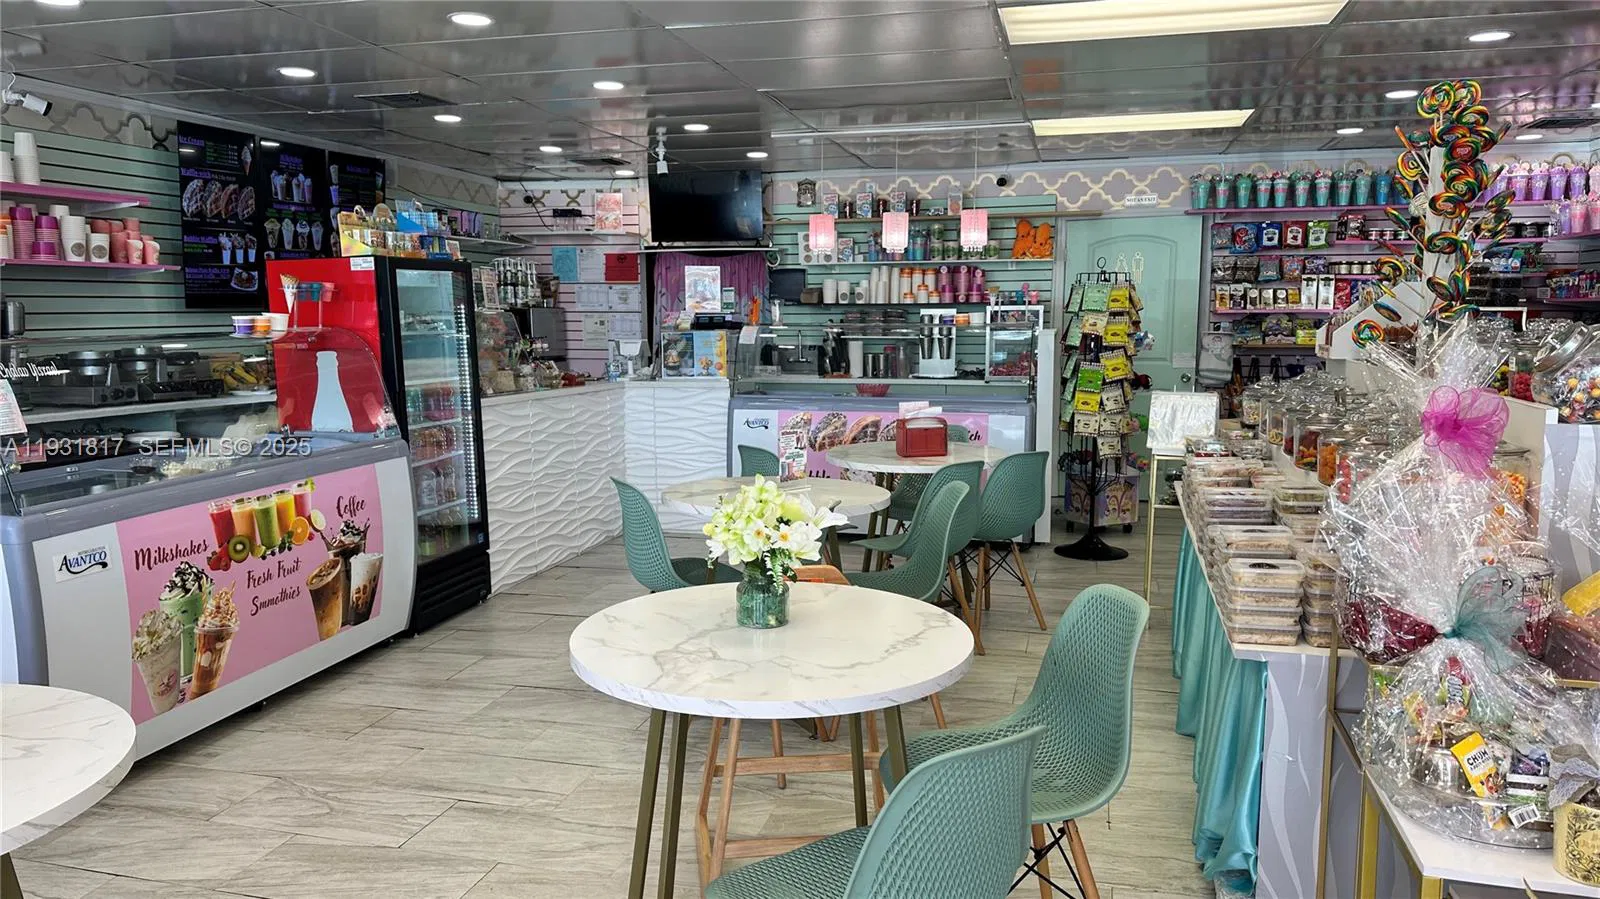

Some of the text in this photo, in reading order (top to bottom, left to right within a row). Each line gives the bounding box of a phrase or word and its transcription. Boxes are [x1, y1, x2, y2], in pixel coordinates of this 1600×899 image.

[336, 495, 366, 516] Coffee
[58, 551, 108, 575] AVANTCO
[134, 539, 209, 572] Milkshakes
[247, 557, 302, 589] Fresh Fruit
